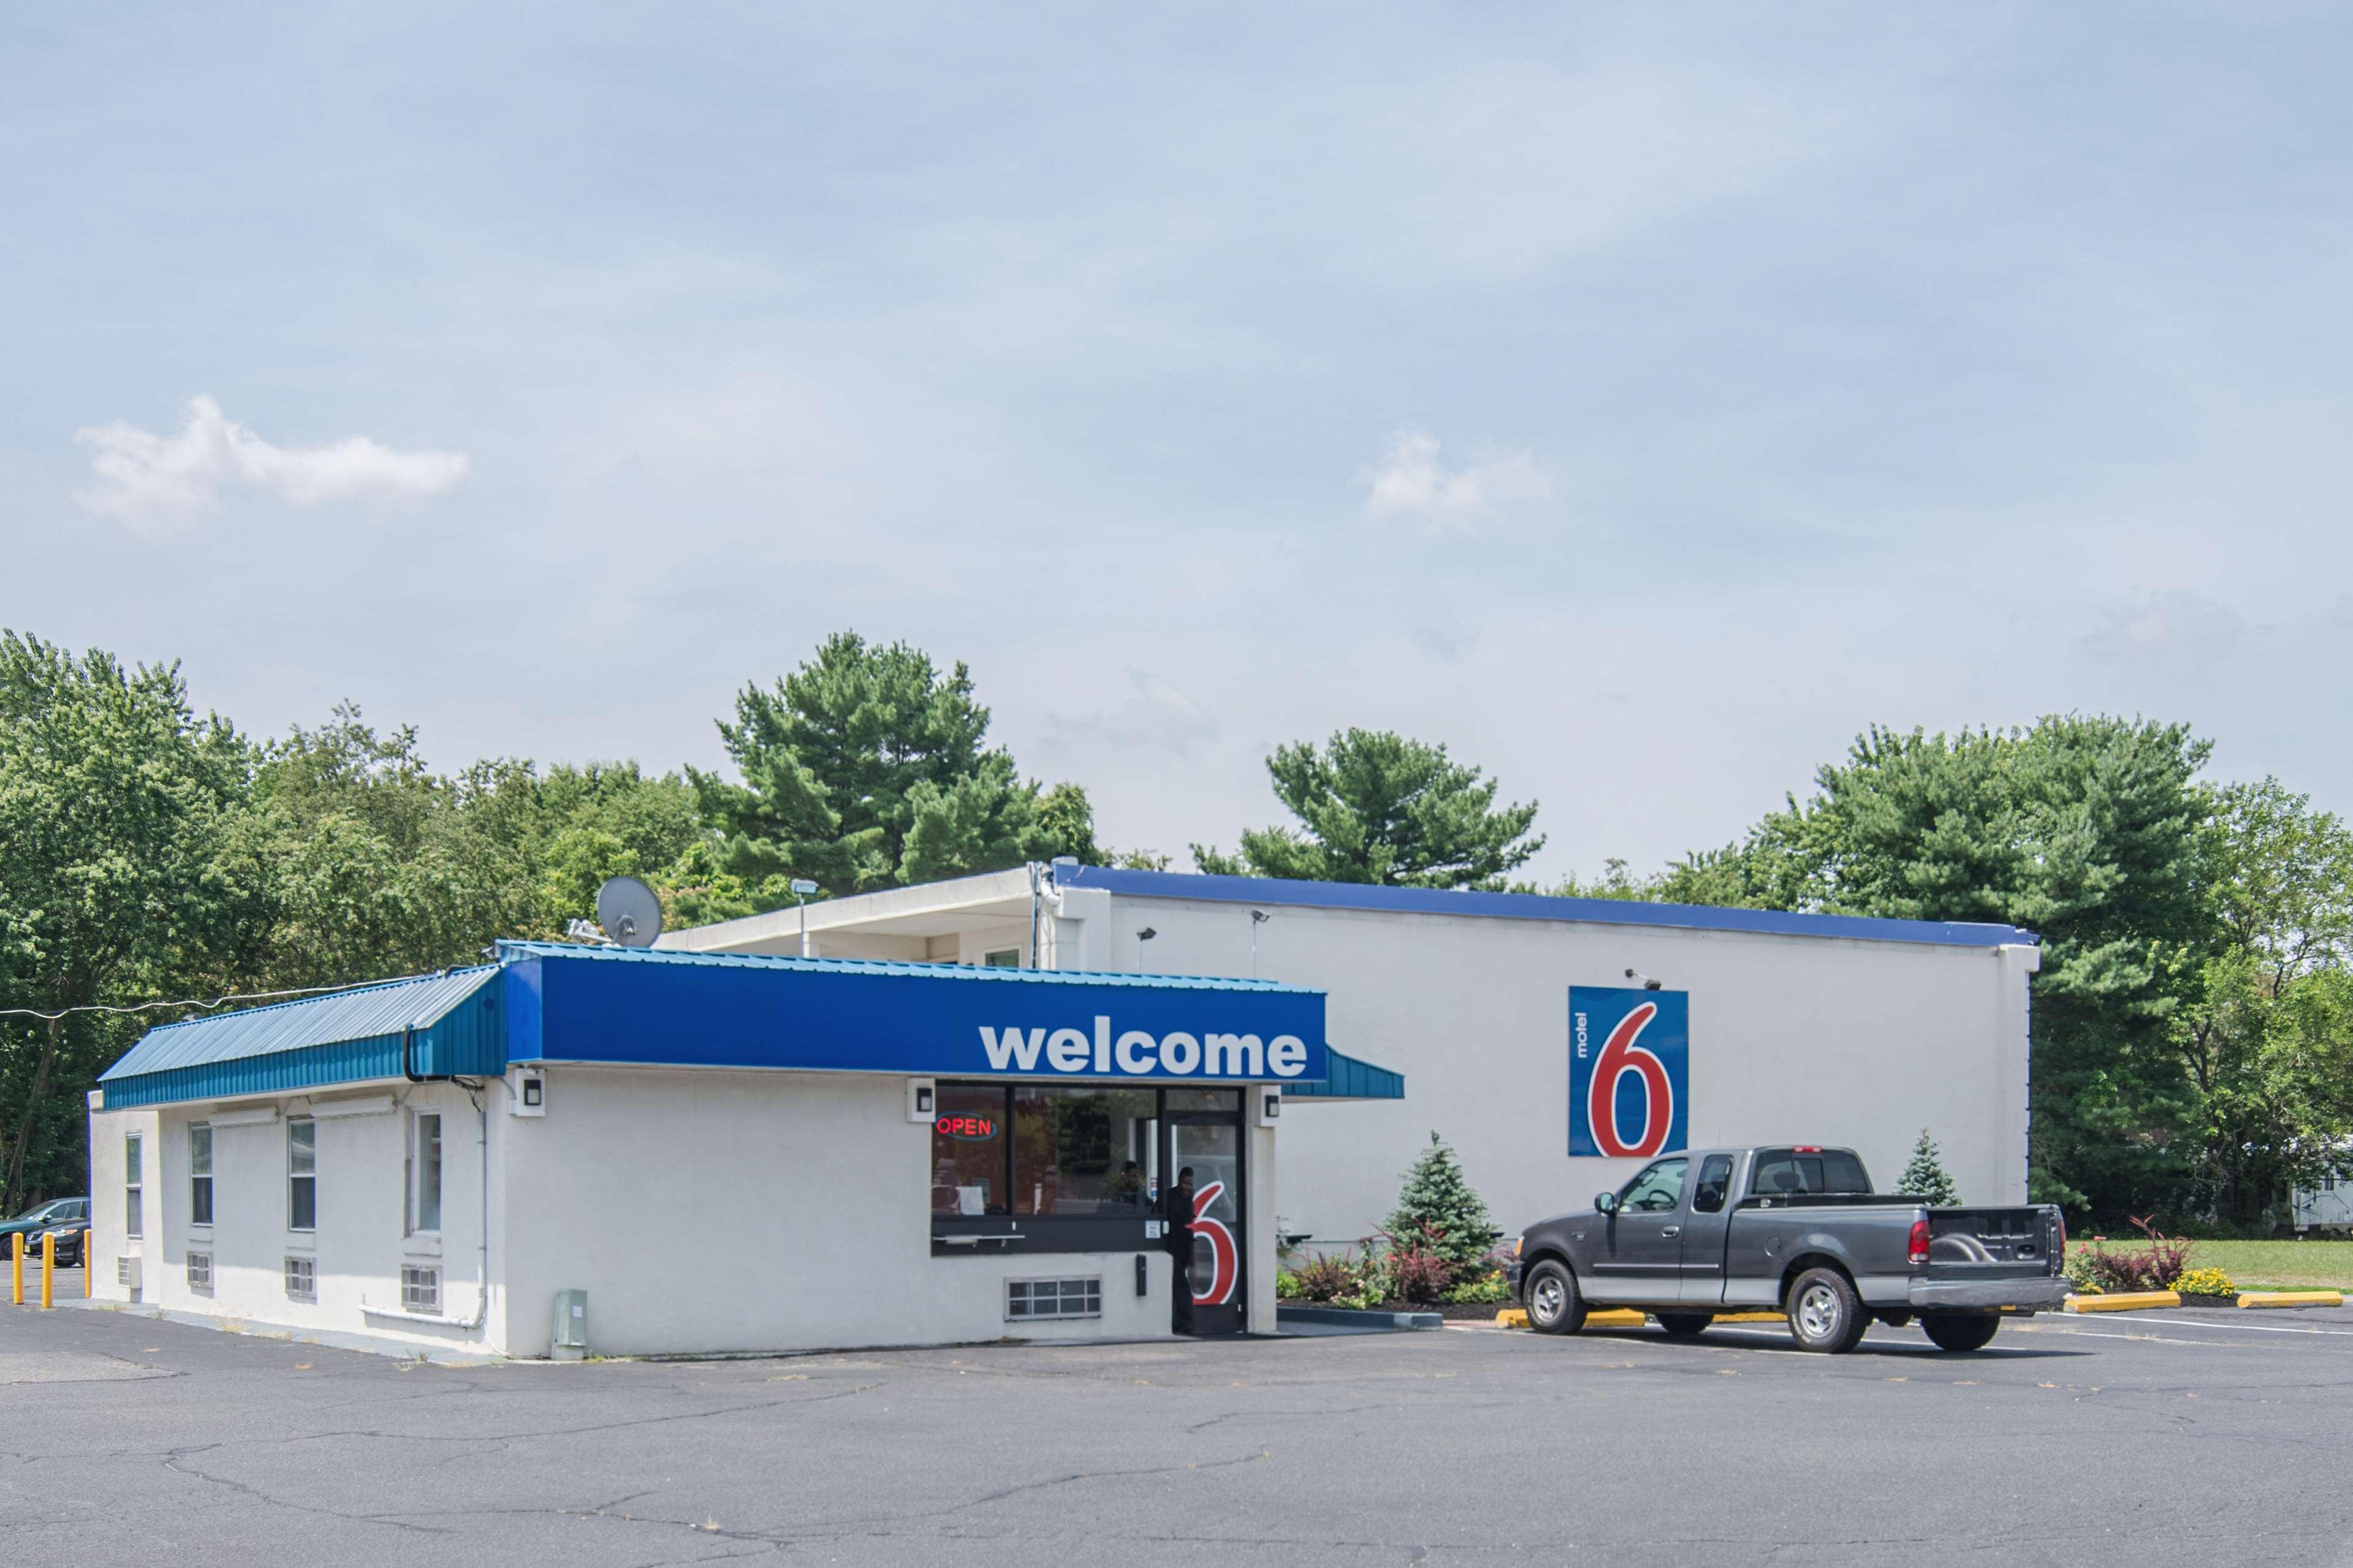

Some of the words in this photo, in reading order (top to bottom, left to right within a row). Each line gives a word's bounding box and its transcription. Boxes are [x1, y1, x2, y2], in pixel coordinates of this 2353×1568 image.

[978, 1015, 1308, 1077] welcome
[1574, 1012, 1587, 1059] motel
[1587, 1001, 1674, 1157] 6
[937, 1117, 991, 1136] OPEN
